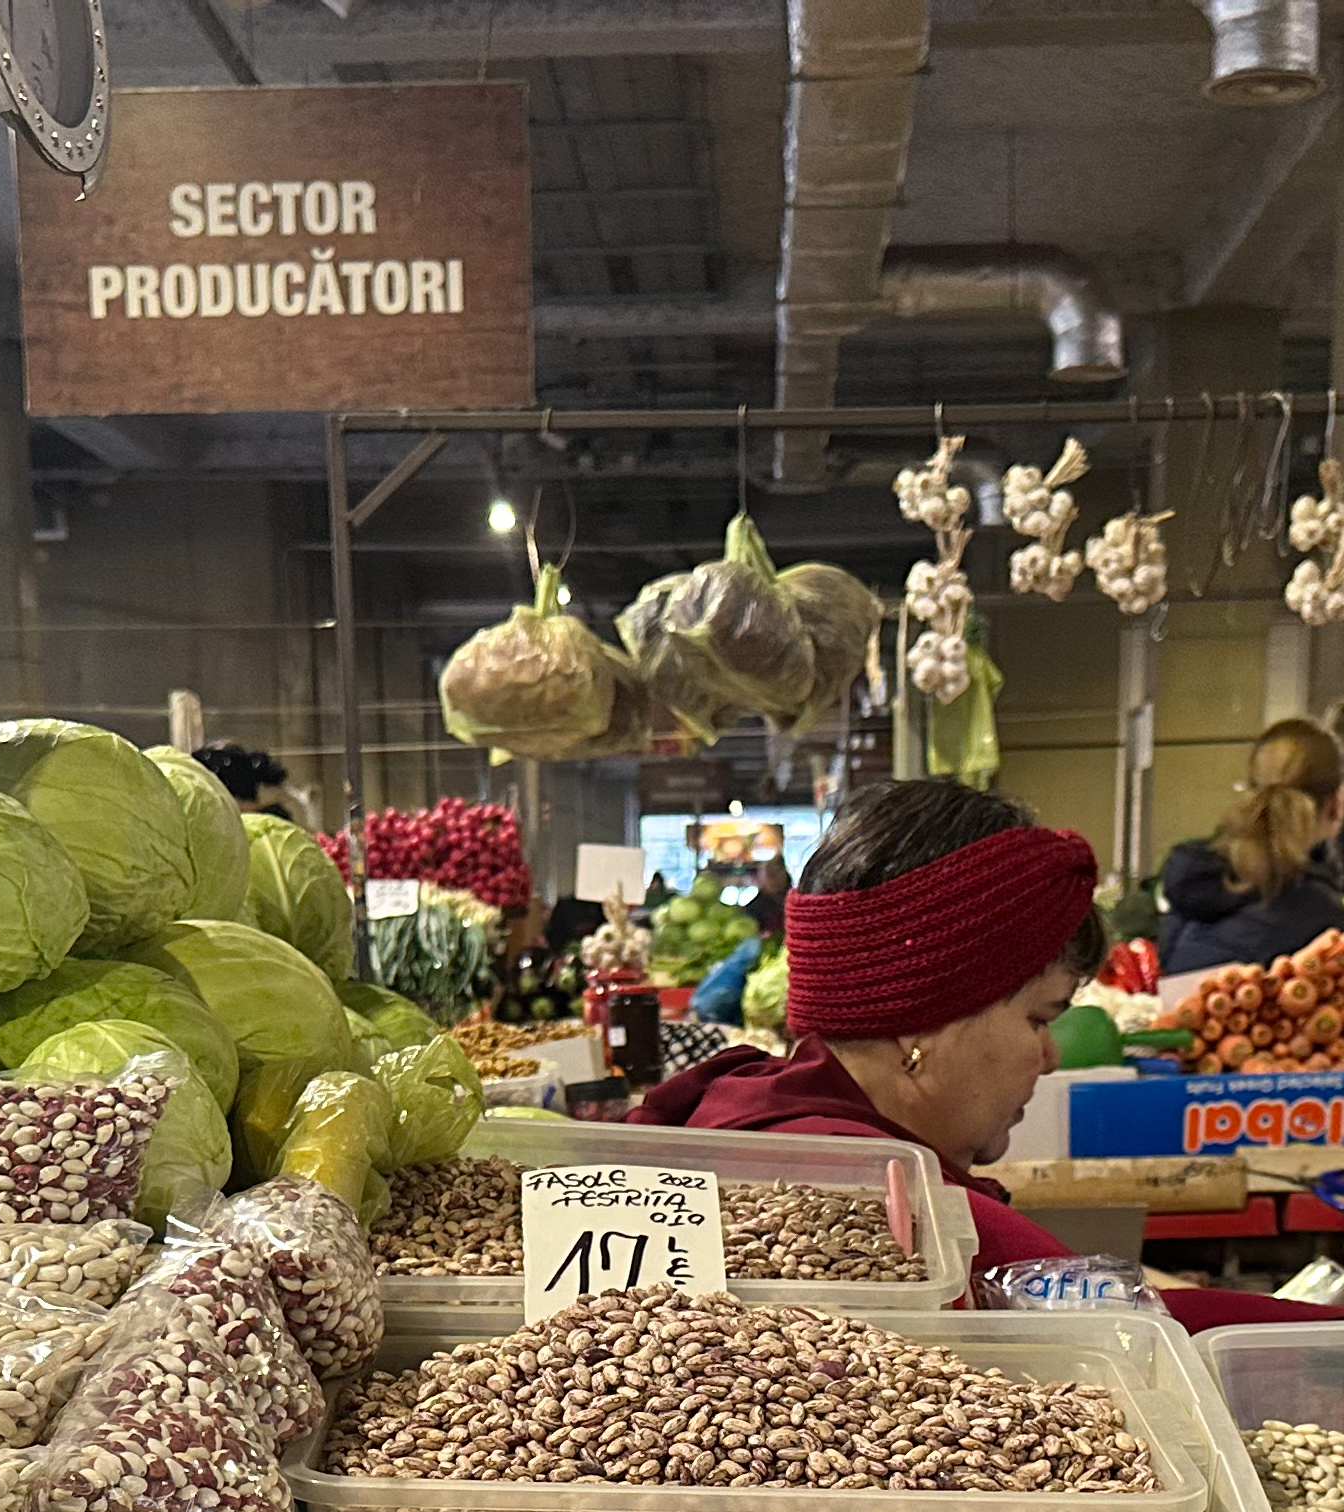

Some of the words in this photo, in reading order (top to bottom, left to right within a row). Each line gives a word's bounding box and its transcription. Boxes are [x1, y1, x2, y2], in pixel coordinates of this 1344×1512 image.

[169, 181, 376, 239] SECTOR
[88, 246, 464, 319] PRODUCĂTORI
[657, 1172, 708, 1190] 2022
[544, 1230, 649, 1295] 17
